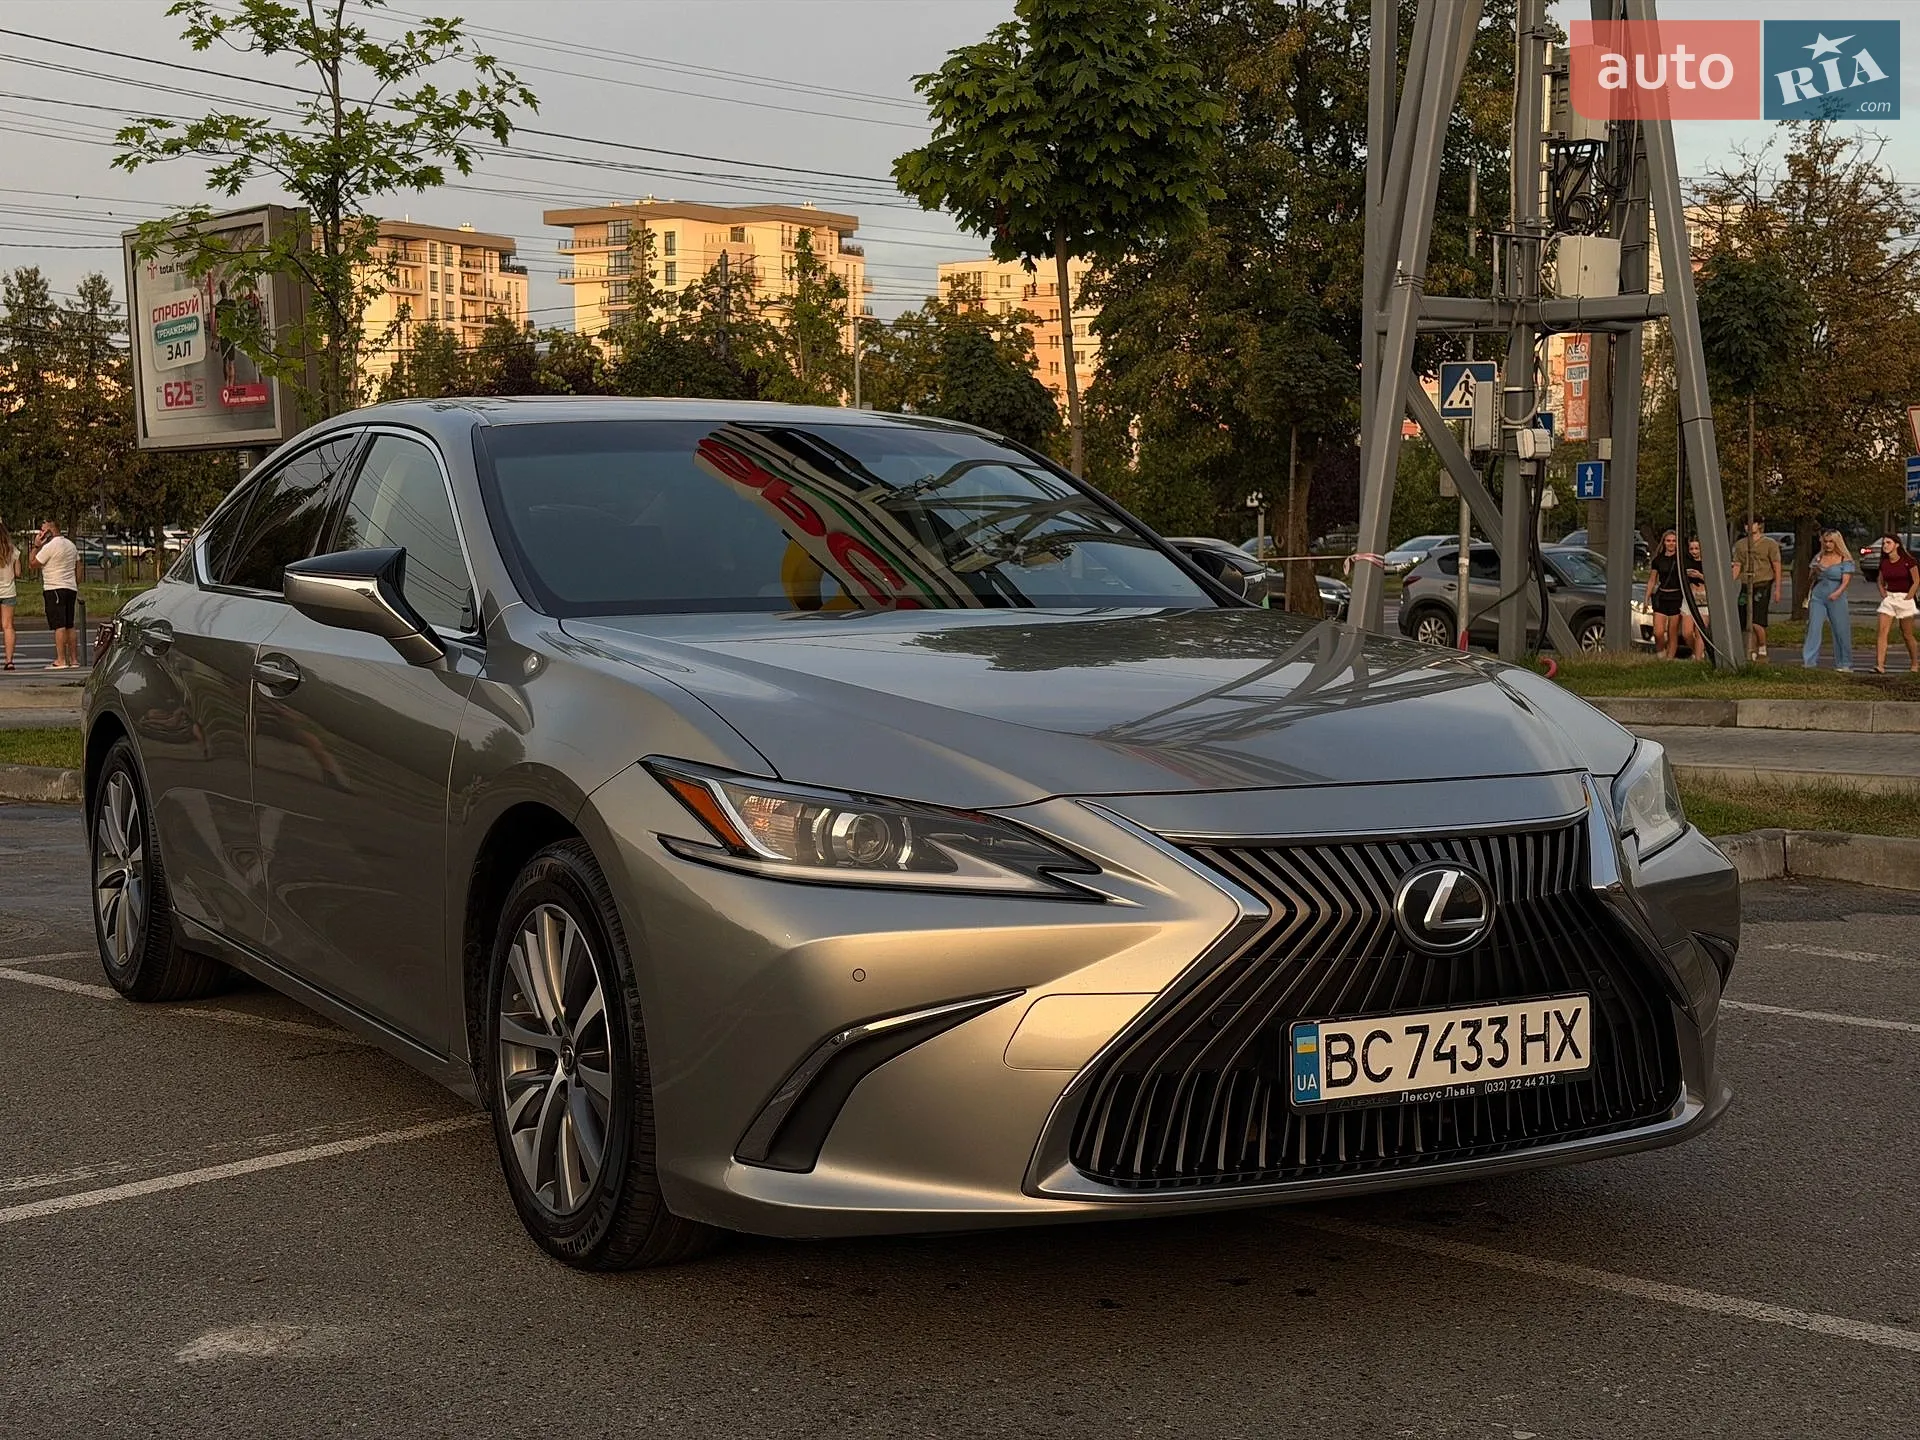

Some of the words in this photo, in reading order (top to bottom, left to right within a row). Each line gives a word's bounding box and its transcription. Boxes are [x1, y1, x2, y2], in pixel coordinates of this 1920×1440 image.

[152, 294, 199, 323] СПРОБУЙ
[156, 320, 197, 339] ТРЕНАЖЕРНИЙ
[166, 340, 191, 361] ЗАЛ
[164, 381, 194, 407] 625
[1325, 1029, 1394, 1088] BC
[1404, 1015, 1510, 1080] 7433
[1520, 1007, 1582, 1066] HX
[1297, 1073, 1318, 1092] UA
[1399, 1091, 1442, 1103] Лексус
[1444, 1085, 1475, 1098] Львів
[1484, 1080, 1507, 1095] (032)
[1509, 1079, 1521, 1090] 22
[1524, 1077, 1536, 1087] 44
[1538, 1074, 1556, 1086] 212
